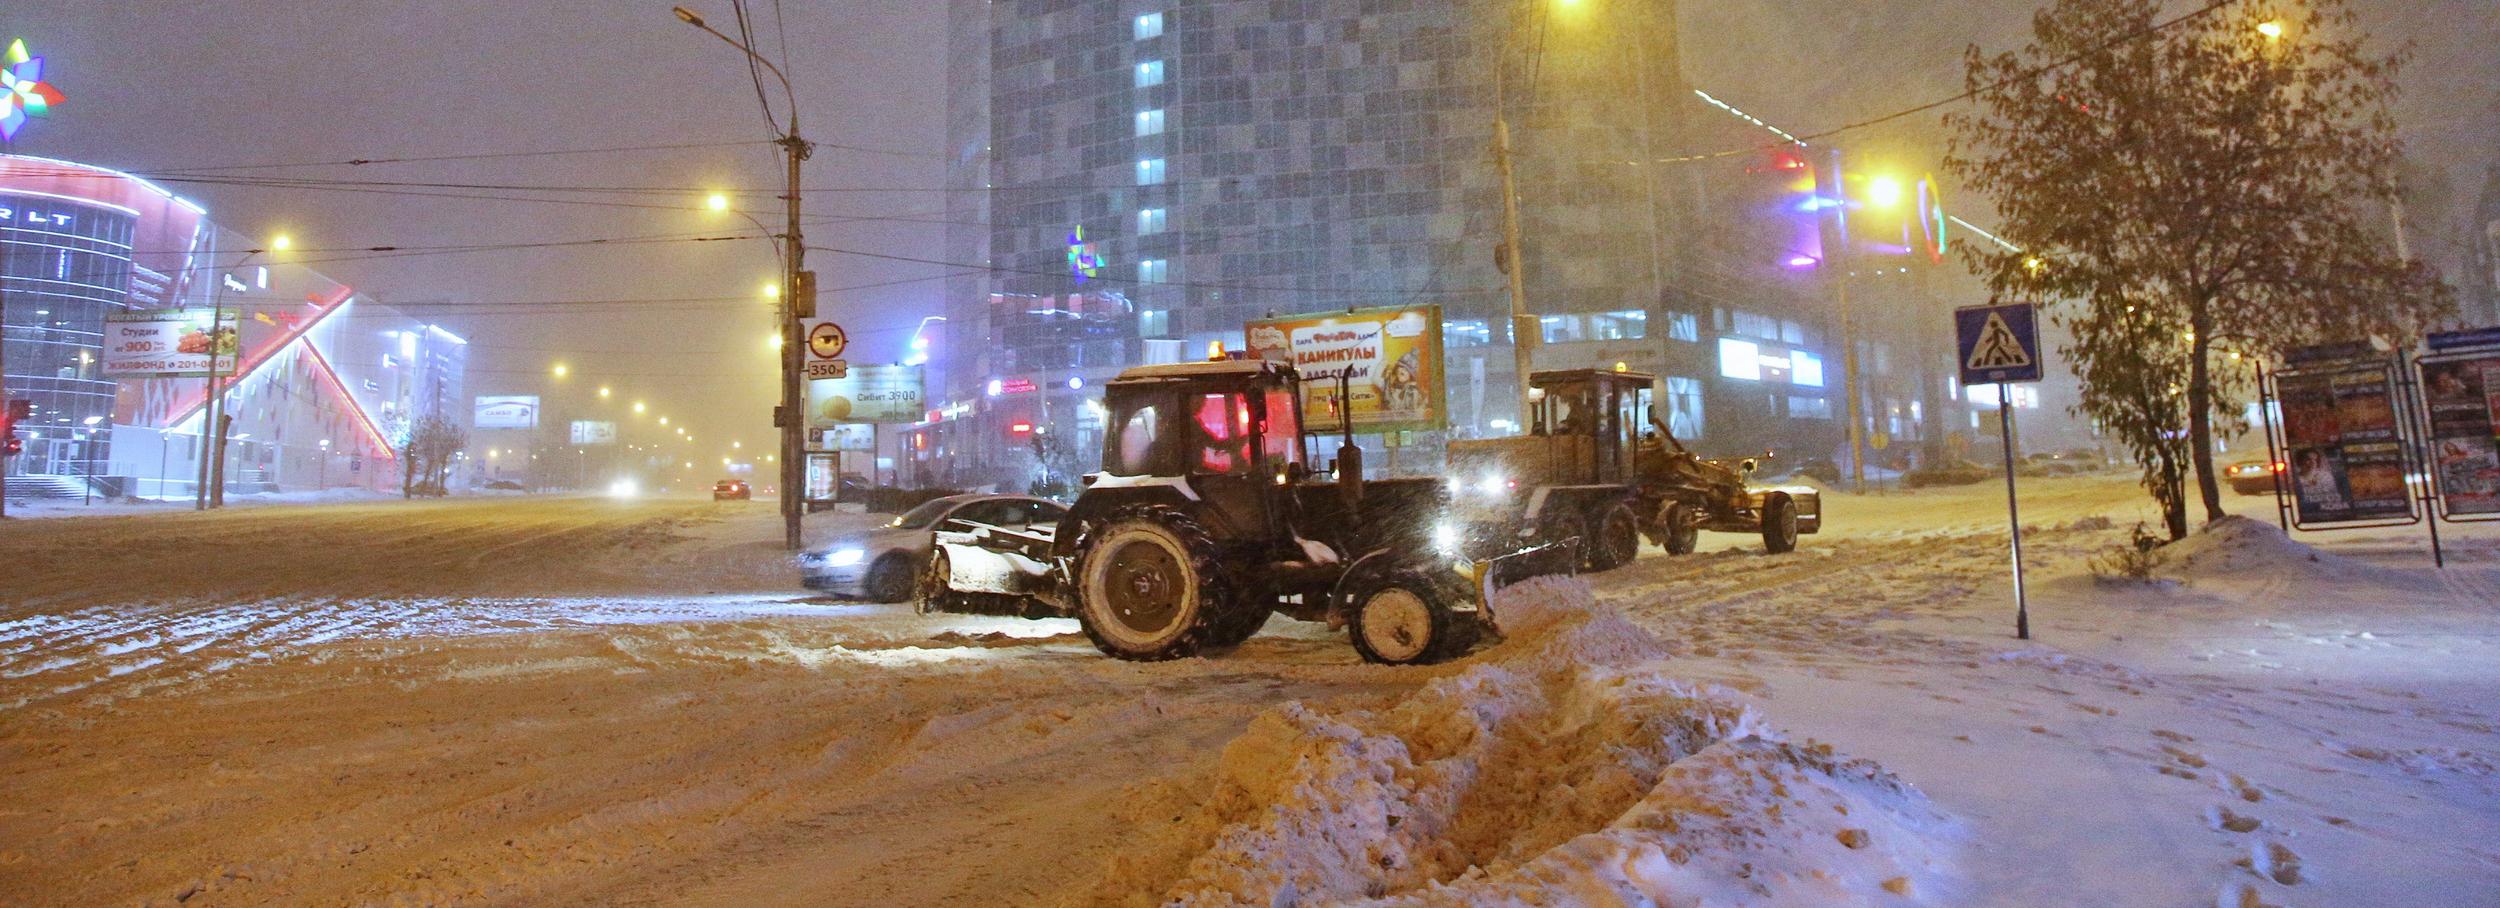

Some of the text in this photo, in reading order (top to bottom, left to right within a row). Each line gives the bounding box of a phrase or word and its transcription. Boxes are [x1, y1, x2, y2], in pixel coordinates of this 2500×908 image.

[121, 328, 159, 337] Студии
[125, 341, 152, 352] 900
[1297, 346, 1376, 364] КАНИКУЛЫ
[108, 360, 165, 370] ЖИЛФОНД
[1306, 367, 1369, 380] ДЛЯ СЕЬИ
[889, 390, 916, 401] 3900
